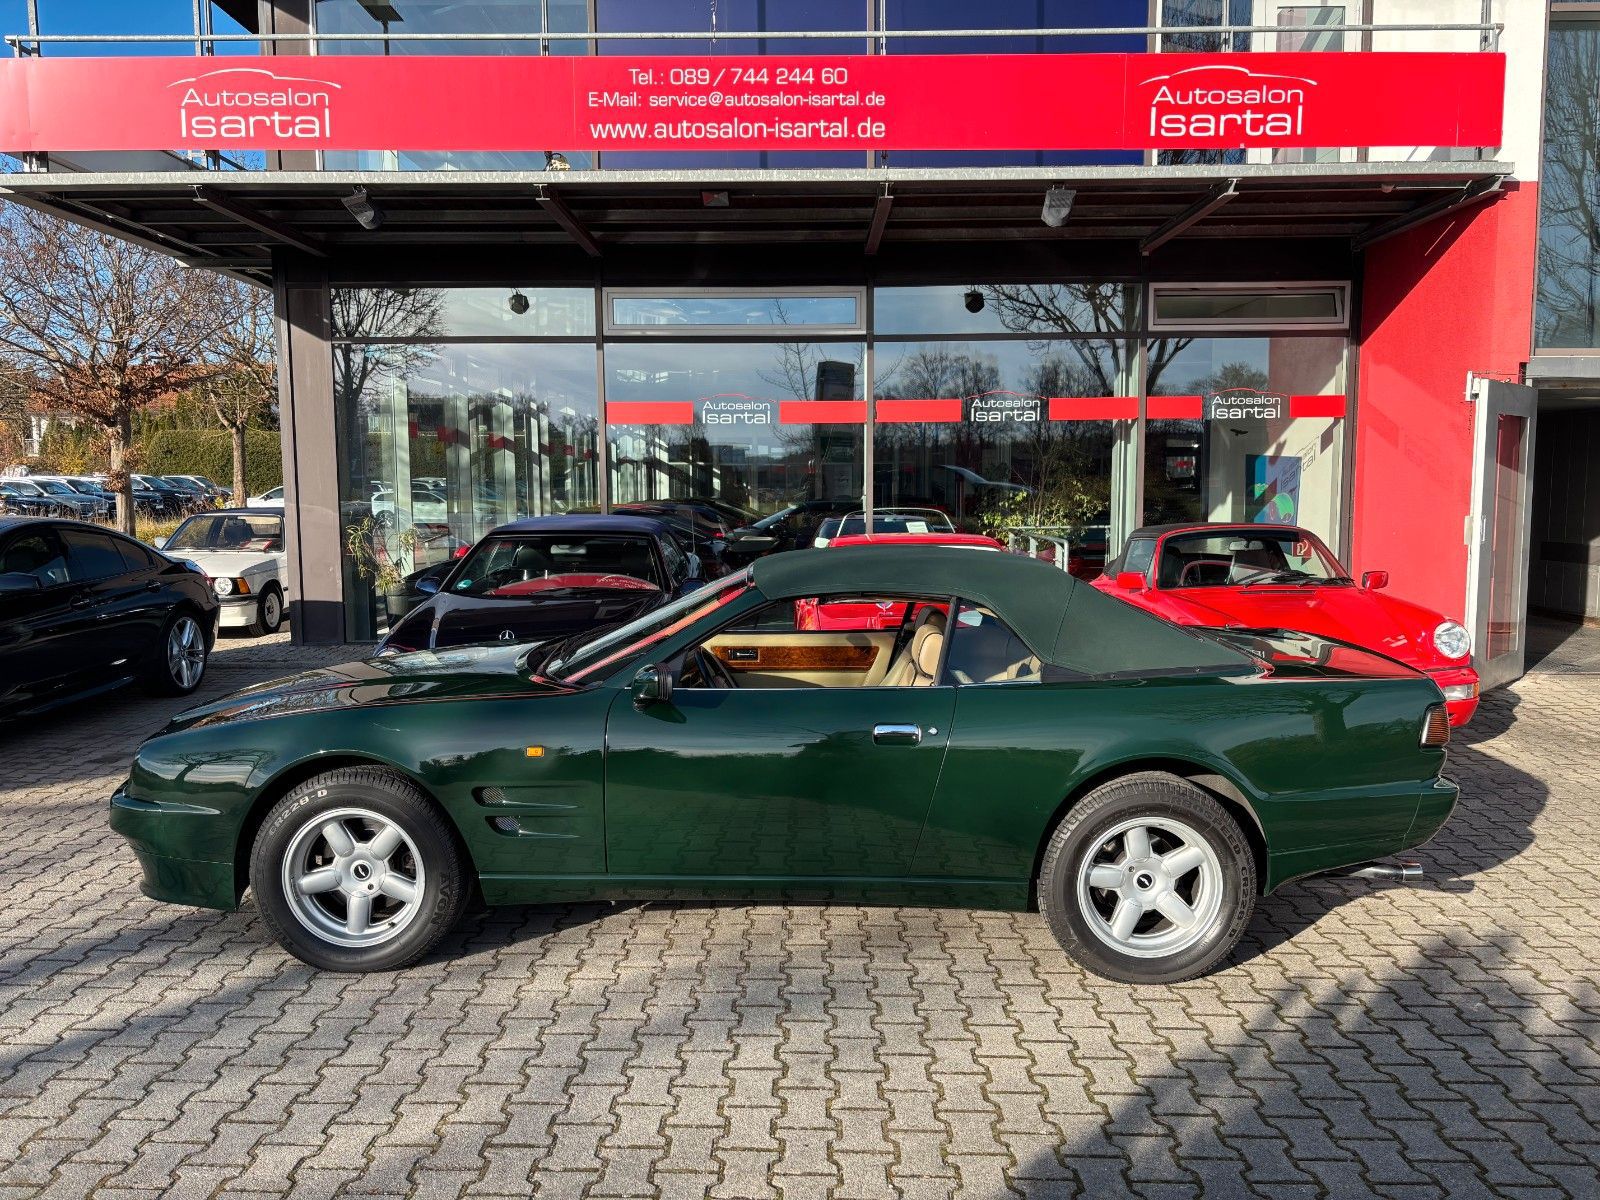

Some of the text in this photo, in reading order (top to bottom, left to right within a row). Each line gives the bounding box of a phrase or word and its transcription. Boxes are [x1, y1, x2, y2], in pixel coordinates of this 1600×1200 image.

[629, 68, 664, 85] Tel.:
[670, 68, 710, 85] 089
[731, 68, 769, 85] 744
[777, 68, 814, 85] 244
[822, 68, 848, 85] 60
[181, 87, 329, 106] Autosalon
[588, 91, 886, 107] E-Mail: service@autosalon-isartal.de
[1153, 85, 1303, 105] Autosalon
[180, 108, 331, 138] Isartal
[590, 117, 886, 139] www.autosalon-isartal.de
[1150, 105, 1303, 137] Isartal
[702, 401, 771, 411] Autosalon
[971, 397, 1041, 408] Autosalon
[1211, 395, 1281, 405] Autosalon
[702, 409, 771, 424] Isartal
[971, 406, 1041, 422] Isartal
[1211, 403, 1281, 419] Isartal
